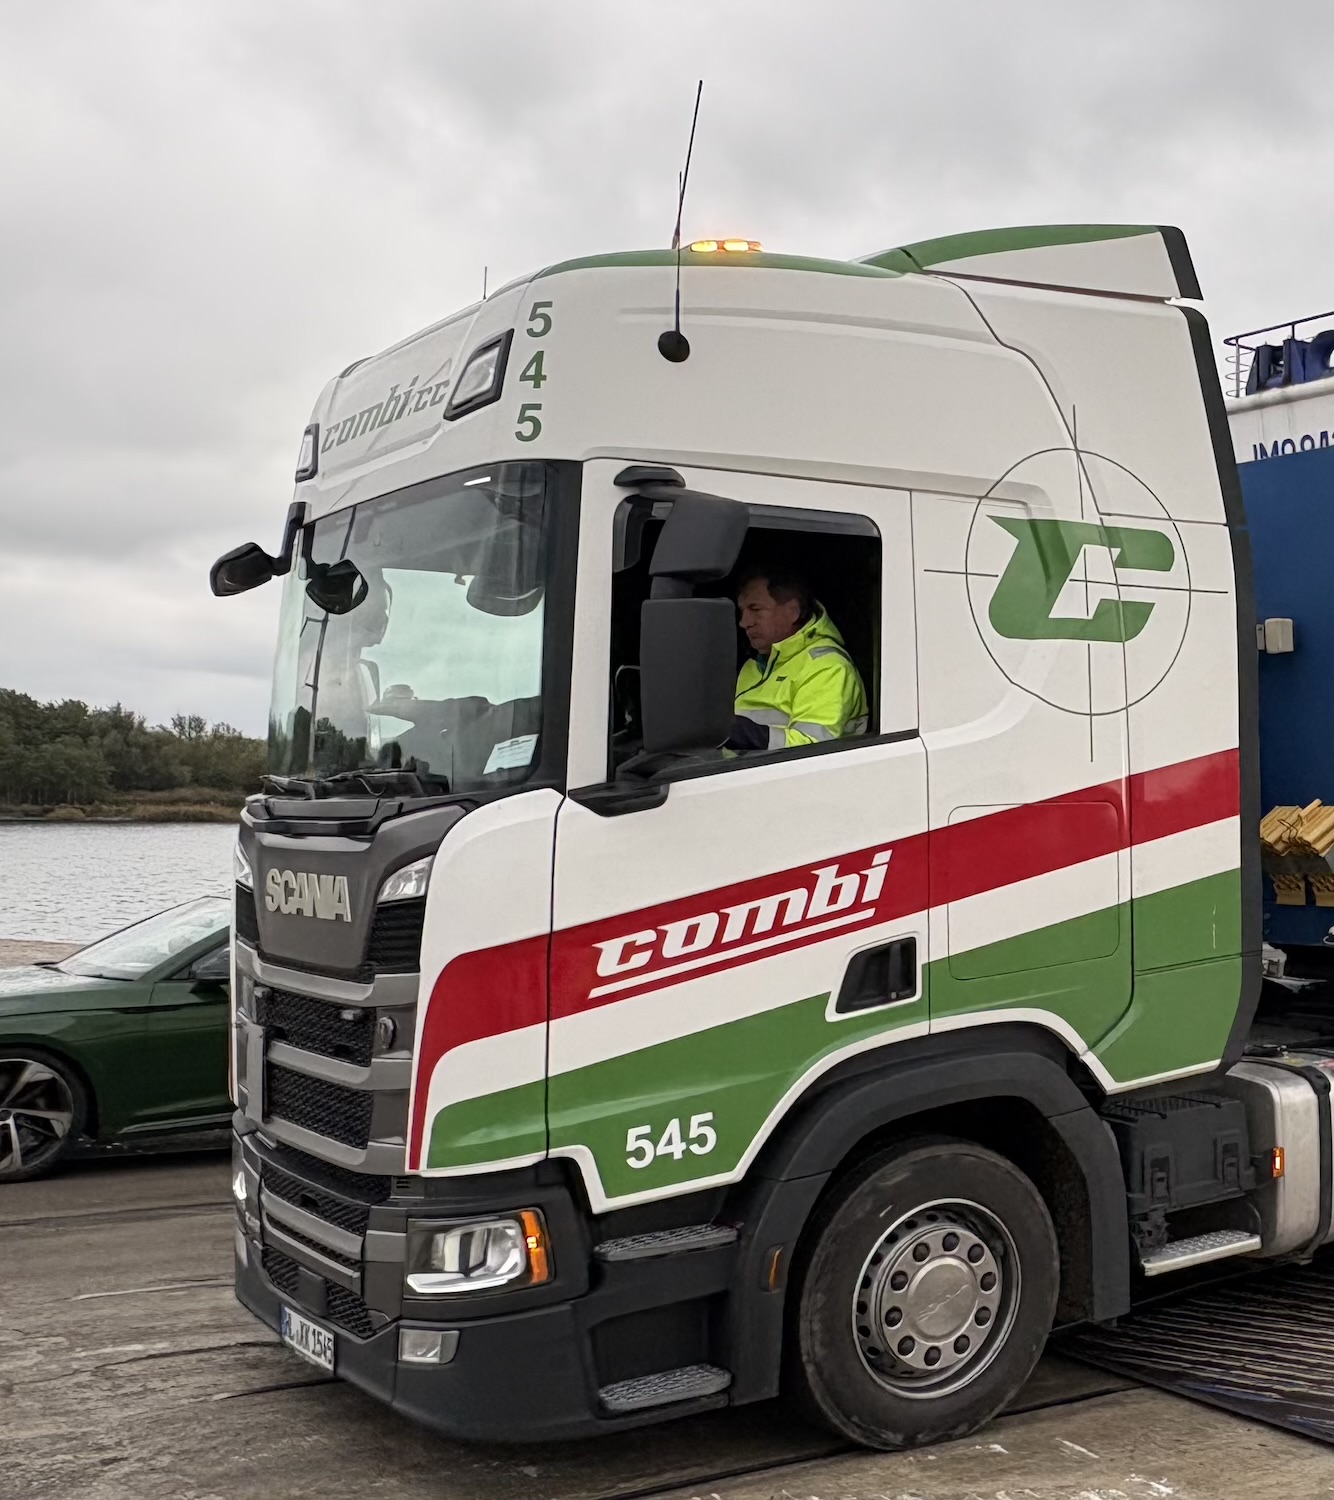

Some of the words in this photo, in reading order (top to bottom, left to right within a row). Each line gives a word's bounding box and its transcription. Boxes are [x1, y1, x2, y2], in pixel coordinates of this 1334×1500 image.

[264, 868, 352, 923] SCANIA
[592, 849, 893, 978] combi
[625, 1112, 717, 1169] 545
